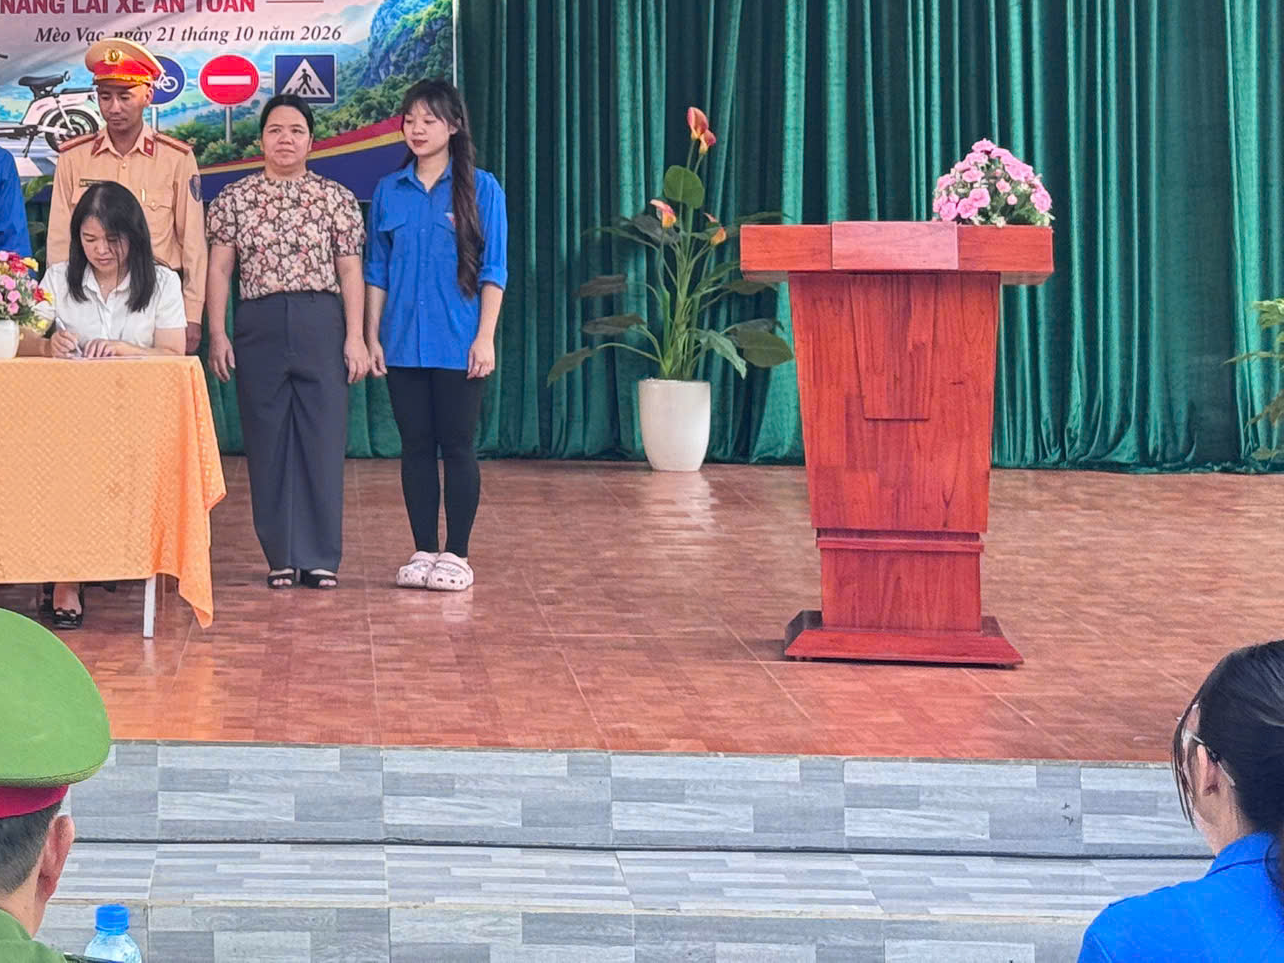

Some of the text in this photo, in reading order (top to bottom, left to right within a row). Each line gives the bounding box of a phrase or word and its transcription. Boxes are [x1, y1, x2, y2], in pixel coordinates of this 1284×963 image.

[35, 27, 71, 42] Mèo
[157, 26, 175, 41] 21
[181, 26, 229, 45] tháng
[235, 26, 253, 41] 10
[258, 26, 295, 41] năm
[300, 26, 342, 41] 2026
